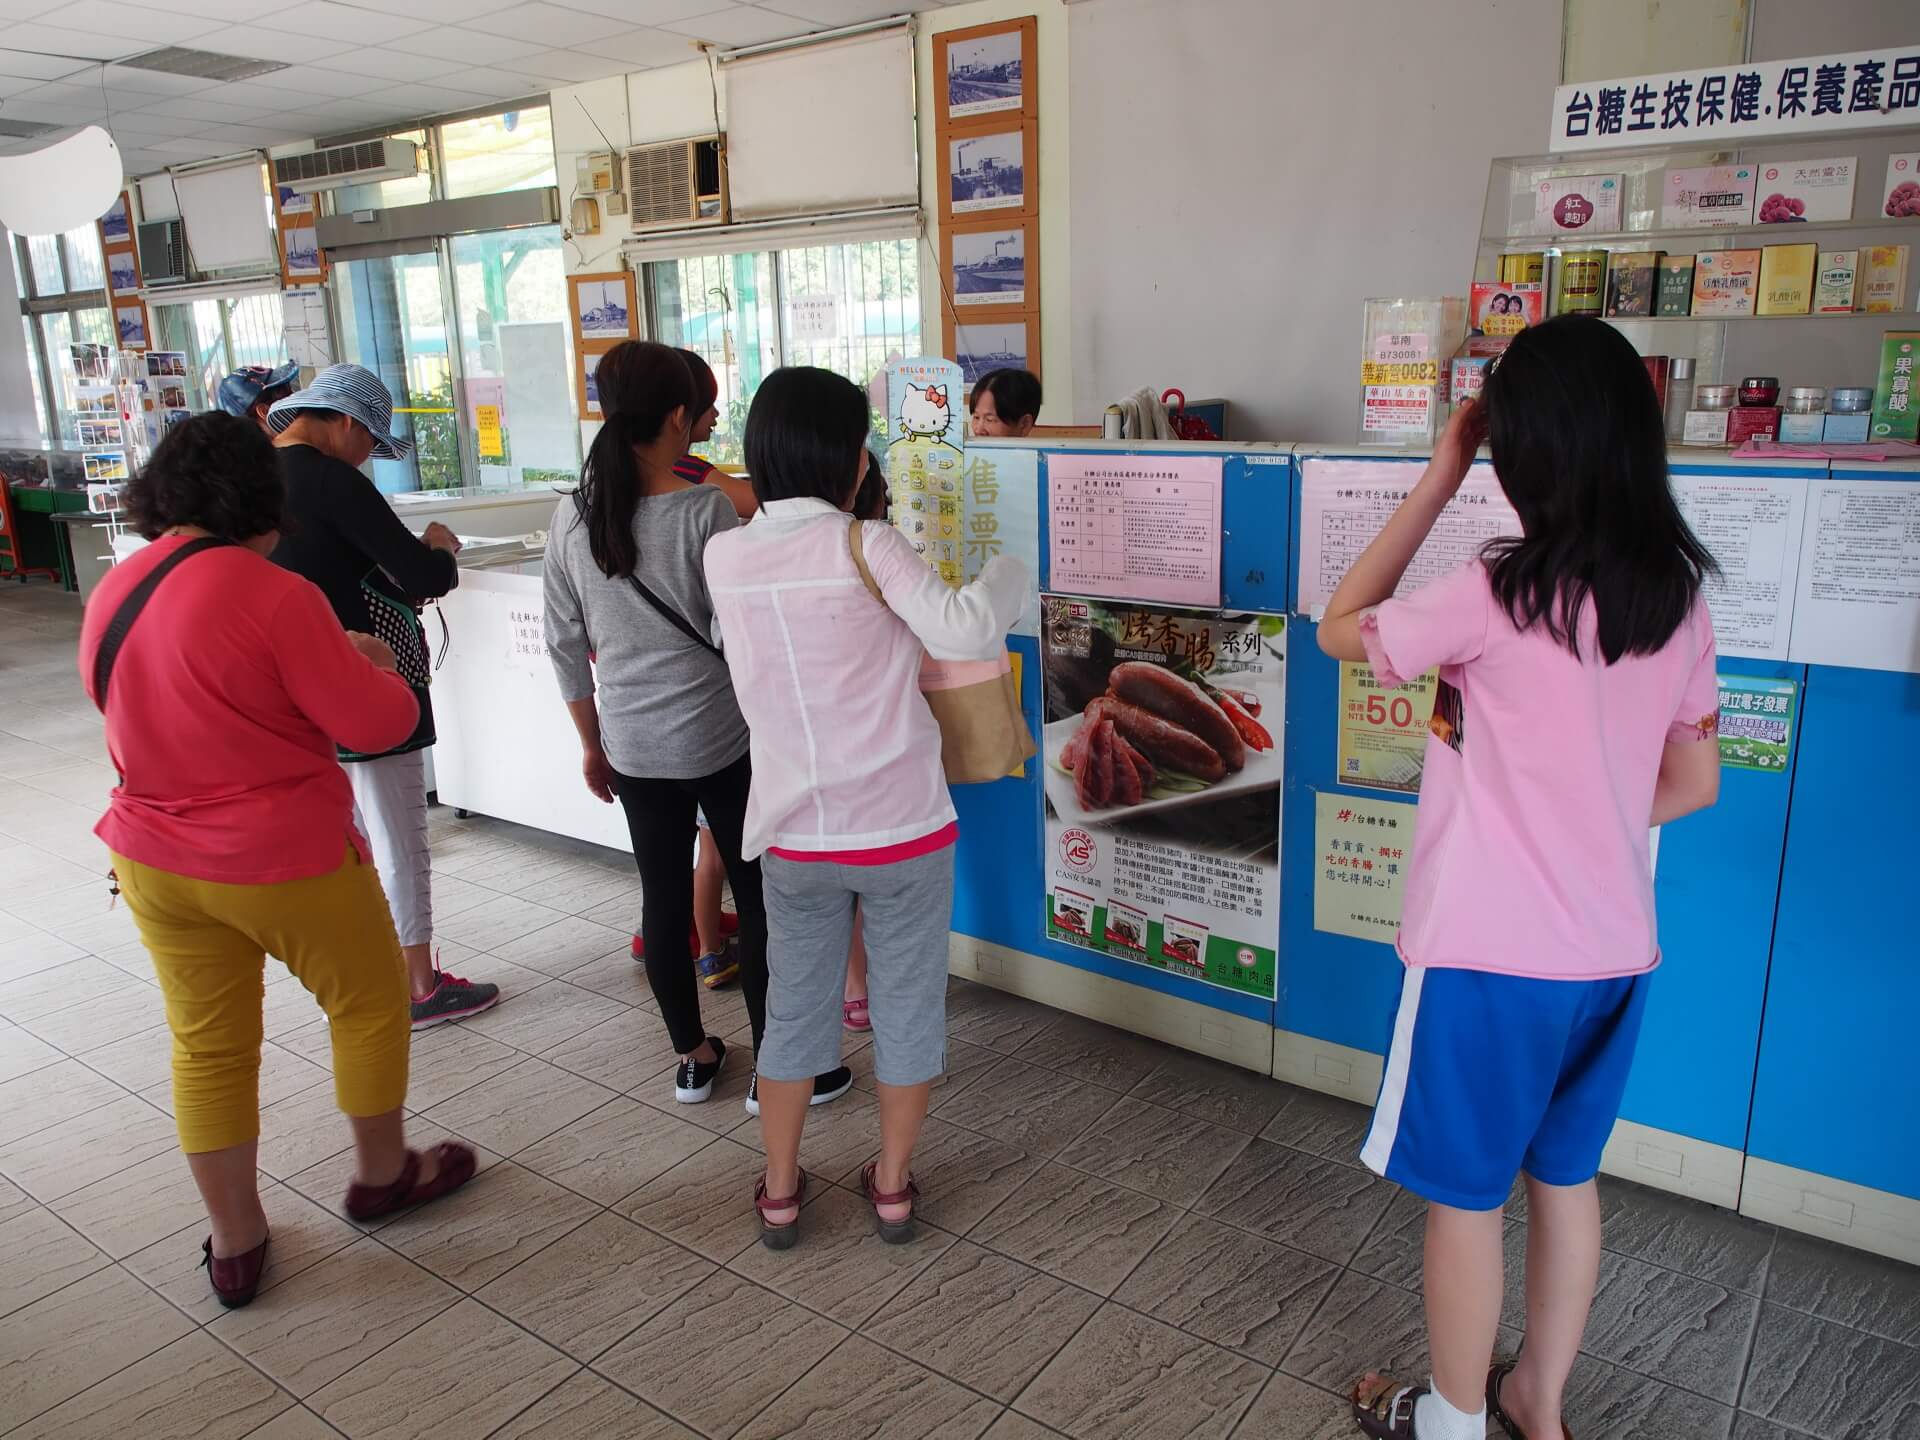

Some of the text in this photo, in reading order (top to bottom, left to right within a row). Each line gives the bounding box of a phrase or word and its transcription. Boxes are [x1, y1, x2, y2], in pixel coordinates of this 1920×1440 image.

[1888, 356, 1913, 413] 果寡醣
[1222, 631, 1261, 657] 系列
[1366, 695, 1412, 727] 50
